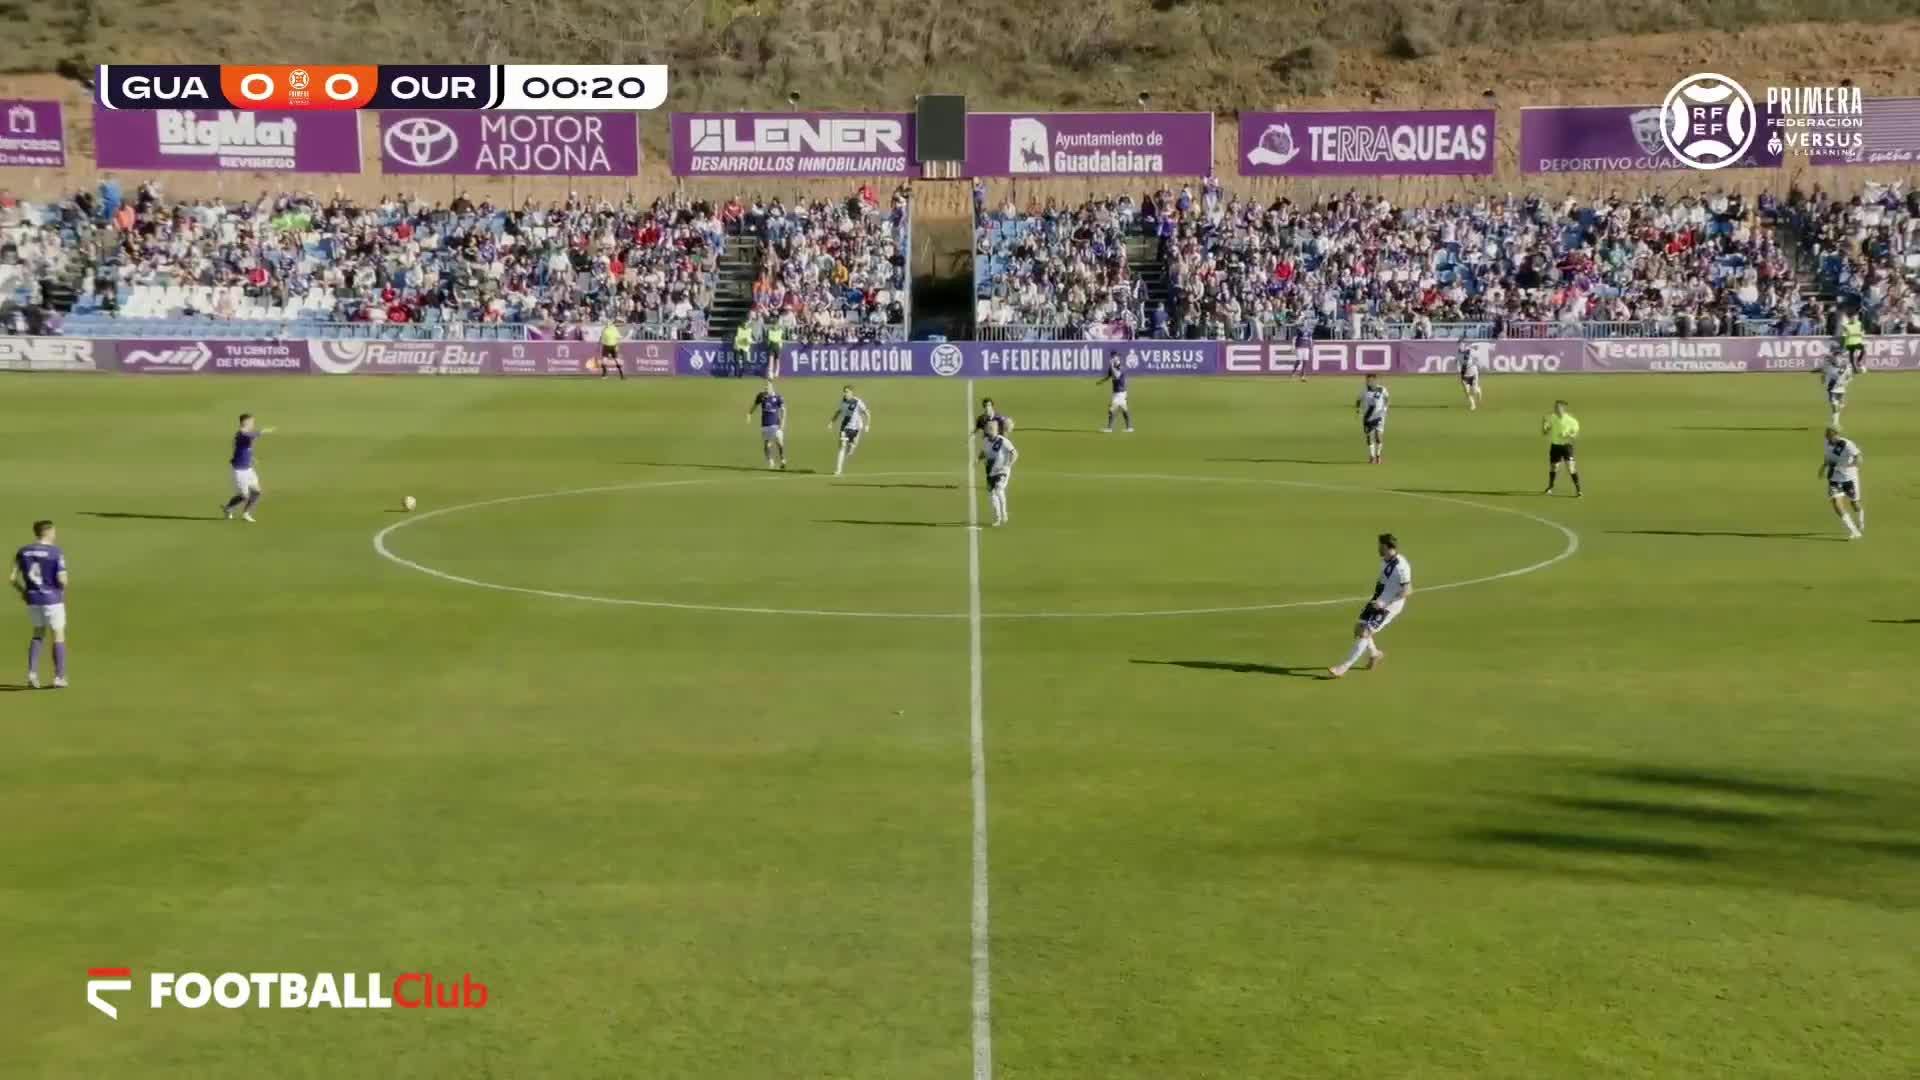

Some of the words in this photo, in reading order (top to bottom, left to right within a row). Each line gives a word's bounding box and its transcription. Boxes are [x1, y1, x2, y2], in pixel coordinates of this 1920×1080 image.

[157, 110, 297, 152] BigMat
[481, 116, 604, 143] MOTOR
[723, 119, 905, 152] LENER
[1055, 131, 1144, 150] Ayuntamiento
[1147, 130, 1163, 146] de
[1308, 124, 1487, 162] TERRAQUEAS
[475, 144, 611, 171] ARJONA
[691, 156, 794, 171] DESARROLLOS
[798, 156, 906, 171] INMOBILIARIOS
[1054, 151, 1163, 173] Guadalajara
[1540, 157, 1632, 171] DEPORTIVO
[225, 346, 241, 355] TU
[244, 346, 289, 355] CENTRO
[811, 347, 912, 371] FEDERACIÓN
[1002, 345, 1103, 370] FEDERACIÓN
[1140, 350, 1204, 362] VERSUS
[1588, 339, 1721, 358] Tecnalum
[216, 358, 232, 368] DE
